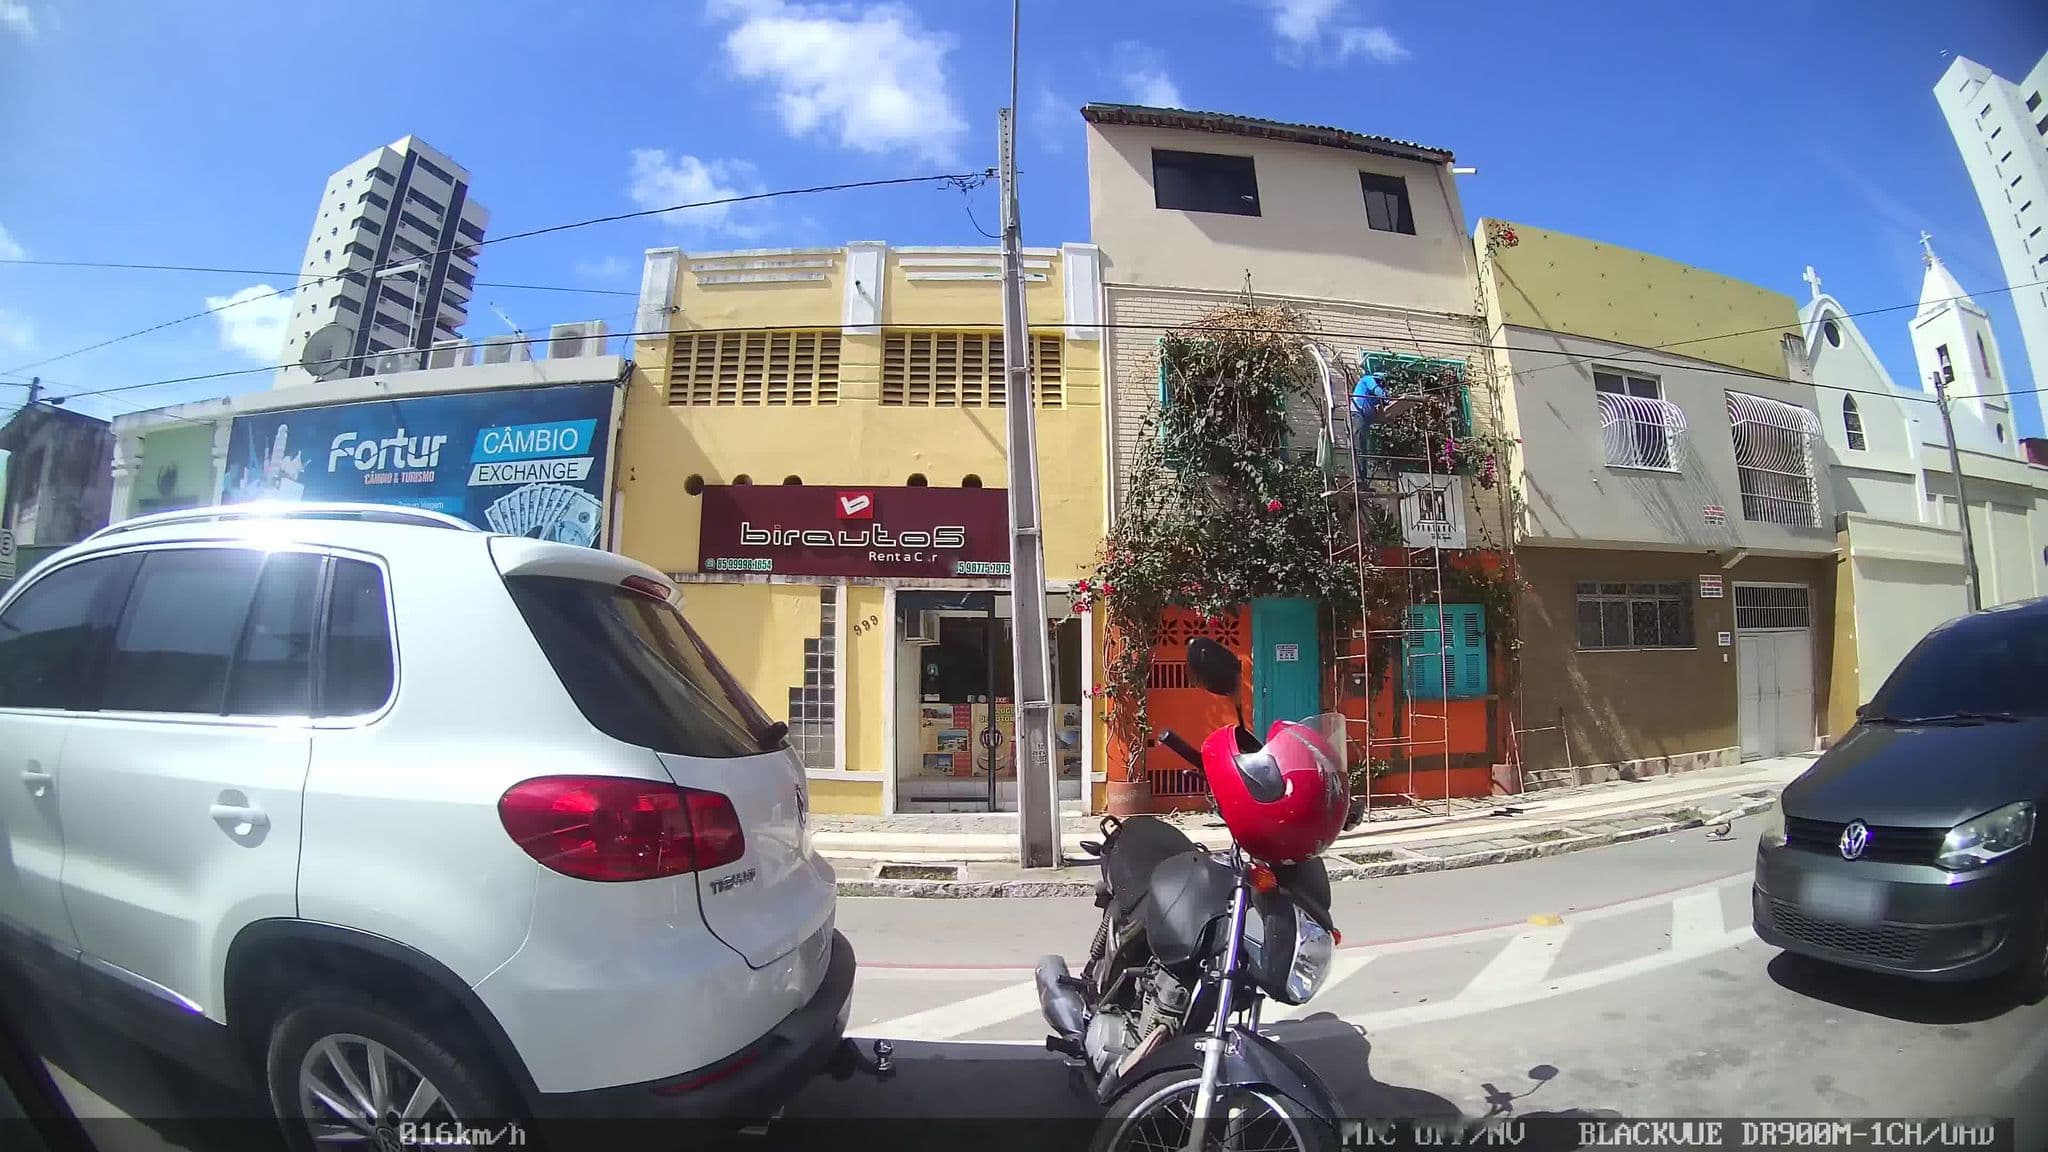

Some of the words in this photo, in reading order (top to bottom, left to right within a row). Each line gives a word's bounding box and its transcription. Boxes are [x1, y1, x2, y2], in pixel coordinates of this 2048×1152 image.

[328, 428, 448, 472] Fortur
[483, 427, 578, 454] CÂMBIO
[401, 471, 435, 484] TURISMO
[478, 463, 579, 481] EXCHANGE
[868, 551, 900, 562] Rent
[903, 554, 911, 562] a
[914, 552, 938, 562] Cr
[853, 615, 878, 637] 999
